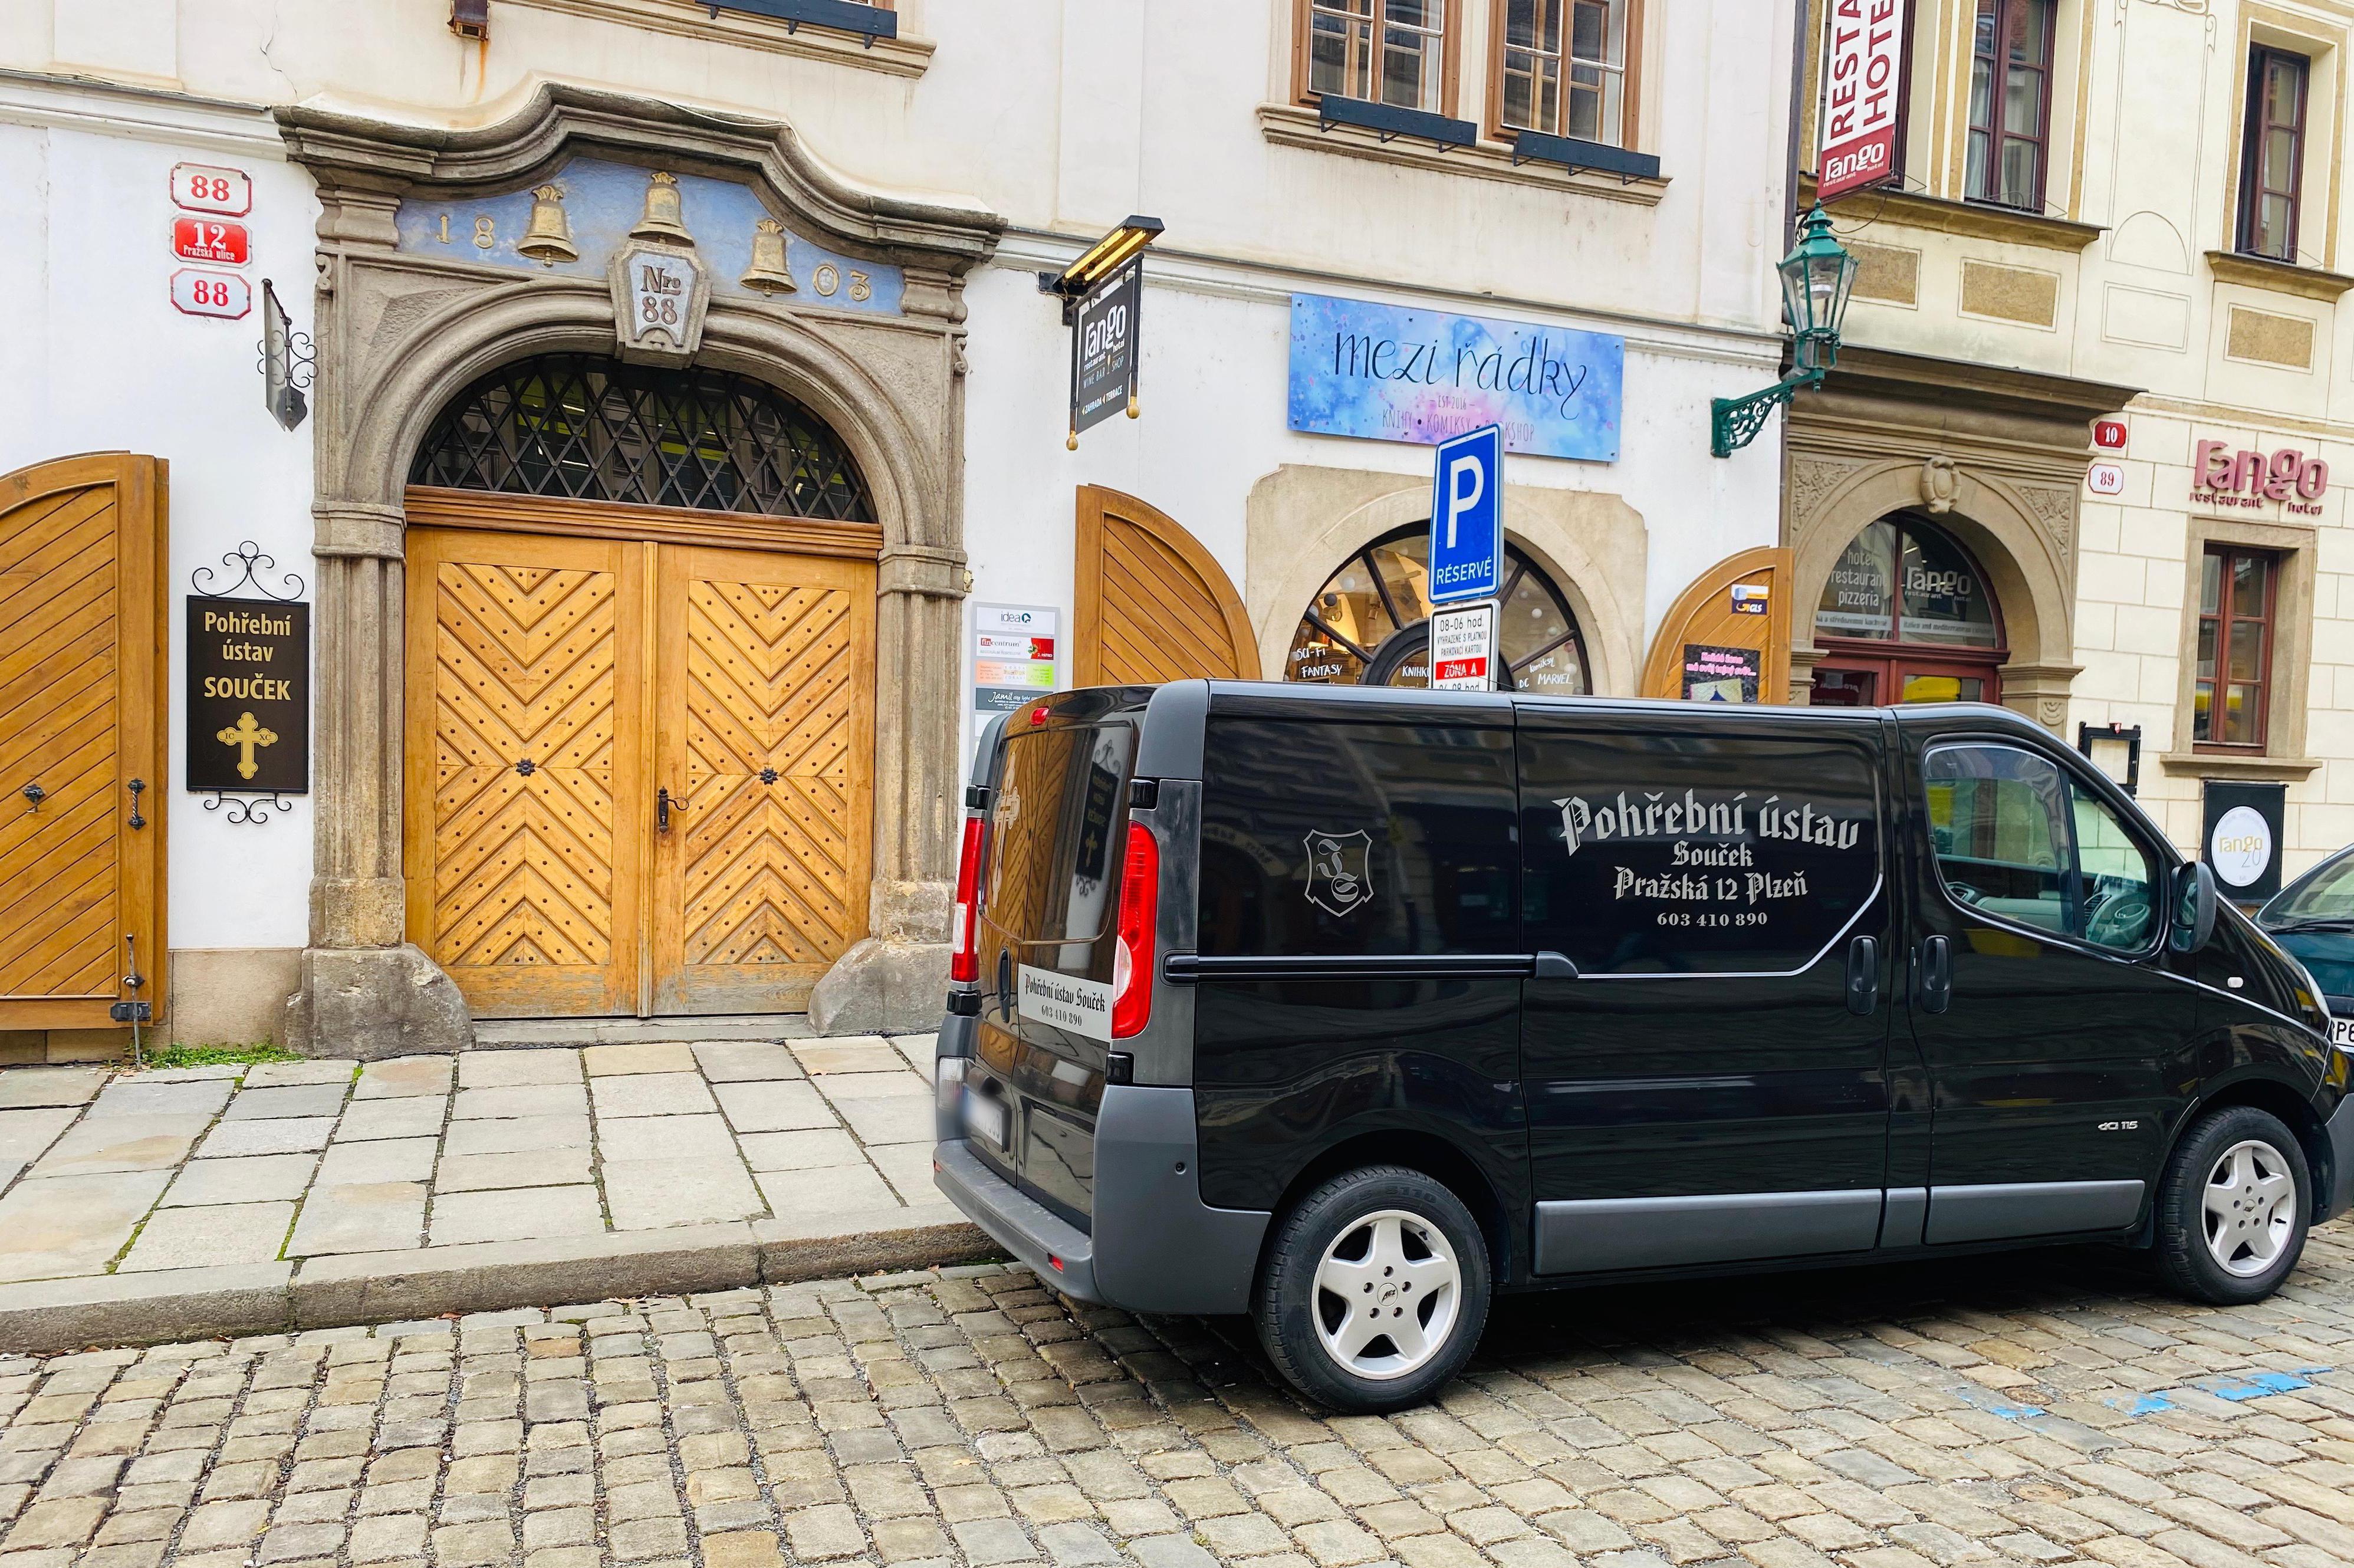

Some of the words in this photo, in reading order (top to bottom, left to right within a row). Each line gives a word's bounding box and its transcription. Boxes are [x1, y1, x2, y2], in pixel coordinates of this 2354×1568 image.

[1867, 161, 1883, 172] hotel
[191, 175, 229, 201] 88
[1823, 172, 1856, 188] restaurant
[193, 222, 226, 249] 12
[183, 244, 213, 258] Pražská
[216, 247, 235, 260] ulice
[193, 280, 228, 306] 88
[642, 296, 677, 325] 88
[1113, 338, 1125, 353] hotel
[1084, 351, 1106, 372] restaurant
[1083, 373, 1094, 389] WINE
[1096, 367, 1105, 382] BAR
[1112, 355, 1124, 372] SHOP
[1335, 331, 1445, 384] mezi
[1456, 336, 1587, 420] řádky
[1085, 397, 1102, 414] ZAHRADA
[1106, 384, 1122, 402] TERRACE
[1438, 395, 1449, 408] EST
[1451, 397, 1467, 409] 2016
[1382, 409, 1412, 429] KNIHY
[1426, 413, 1472, 434] KOMIKSY
[2105, 426, 2118, 443] 10
[2099, 471, 2115, 486] 89
[1446, 455, 1484, 549] P
[2189, 491, 2264, 509] restaurant
[2287, 501, 2323, 515] hotel
[1436, 555, 1492, 586] RÉSERVÉ
[1830, 568, 1887, 588] restaurant
[1837, 589, 1879, 607] pizzeria
[205, 611, 292, 636] Pohřební
[1001, 611, 1020, 623] idea
[1440, 617, 1463, 632] 08-06
[981, 637, 1019, 647] fincentrum
[1463, 633, 1466, 642] S
[1468, 631, 1487, 640] PLATNOU
[222, 639, 273, 662] ústav
[1296, 647, 1326, 661] SCI-FI
[1465, 644, 1481, 654] KARTOU
[1301, 664, 1343, 678] FANTASY
[1444, 660, 1467, 678] ZÓNA
[1470, 662, 1477, 675] A
[1529, 657, 1555, 673] komiksy
[204, 672, 291, 701] SOUČEK
[1519, 678, 1530, 688] DC
[1537, 673, 1573, 685] MARVEL
[988, 691, 1013, 702] Jamil
[1551, 788, 1747, 856] Pohřební
[1759, 795, 1859, 850] ústav
[1671, 840, 1754, 867] Souček
[2241, 848, 2261, 867] 20
[1614, 866, 1709, 900] Pražská
[1717, 878, 1738, 900] 12
[1744, 870, 1809, 906] Plzeň
[1656, 912, 1691, 926] 603
[1696, 913, 1730, 927] 410
[1735, 912, 1768, 926] 890
[1025, 973, 1054, 999] Pohřební
[1055, 983, 1074, 1004] ústav
[1076, 987, 1105, 1012] Souček
[1041, 1004, 1053, 1018] 603
[1056, 1008, 1067, 1022] 410
[1069, 1013, 1082, 1027] 890
[2121, 1120, 2138, 1130] 115
